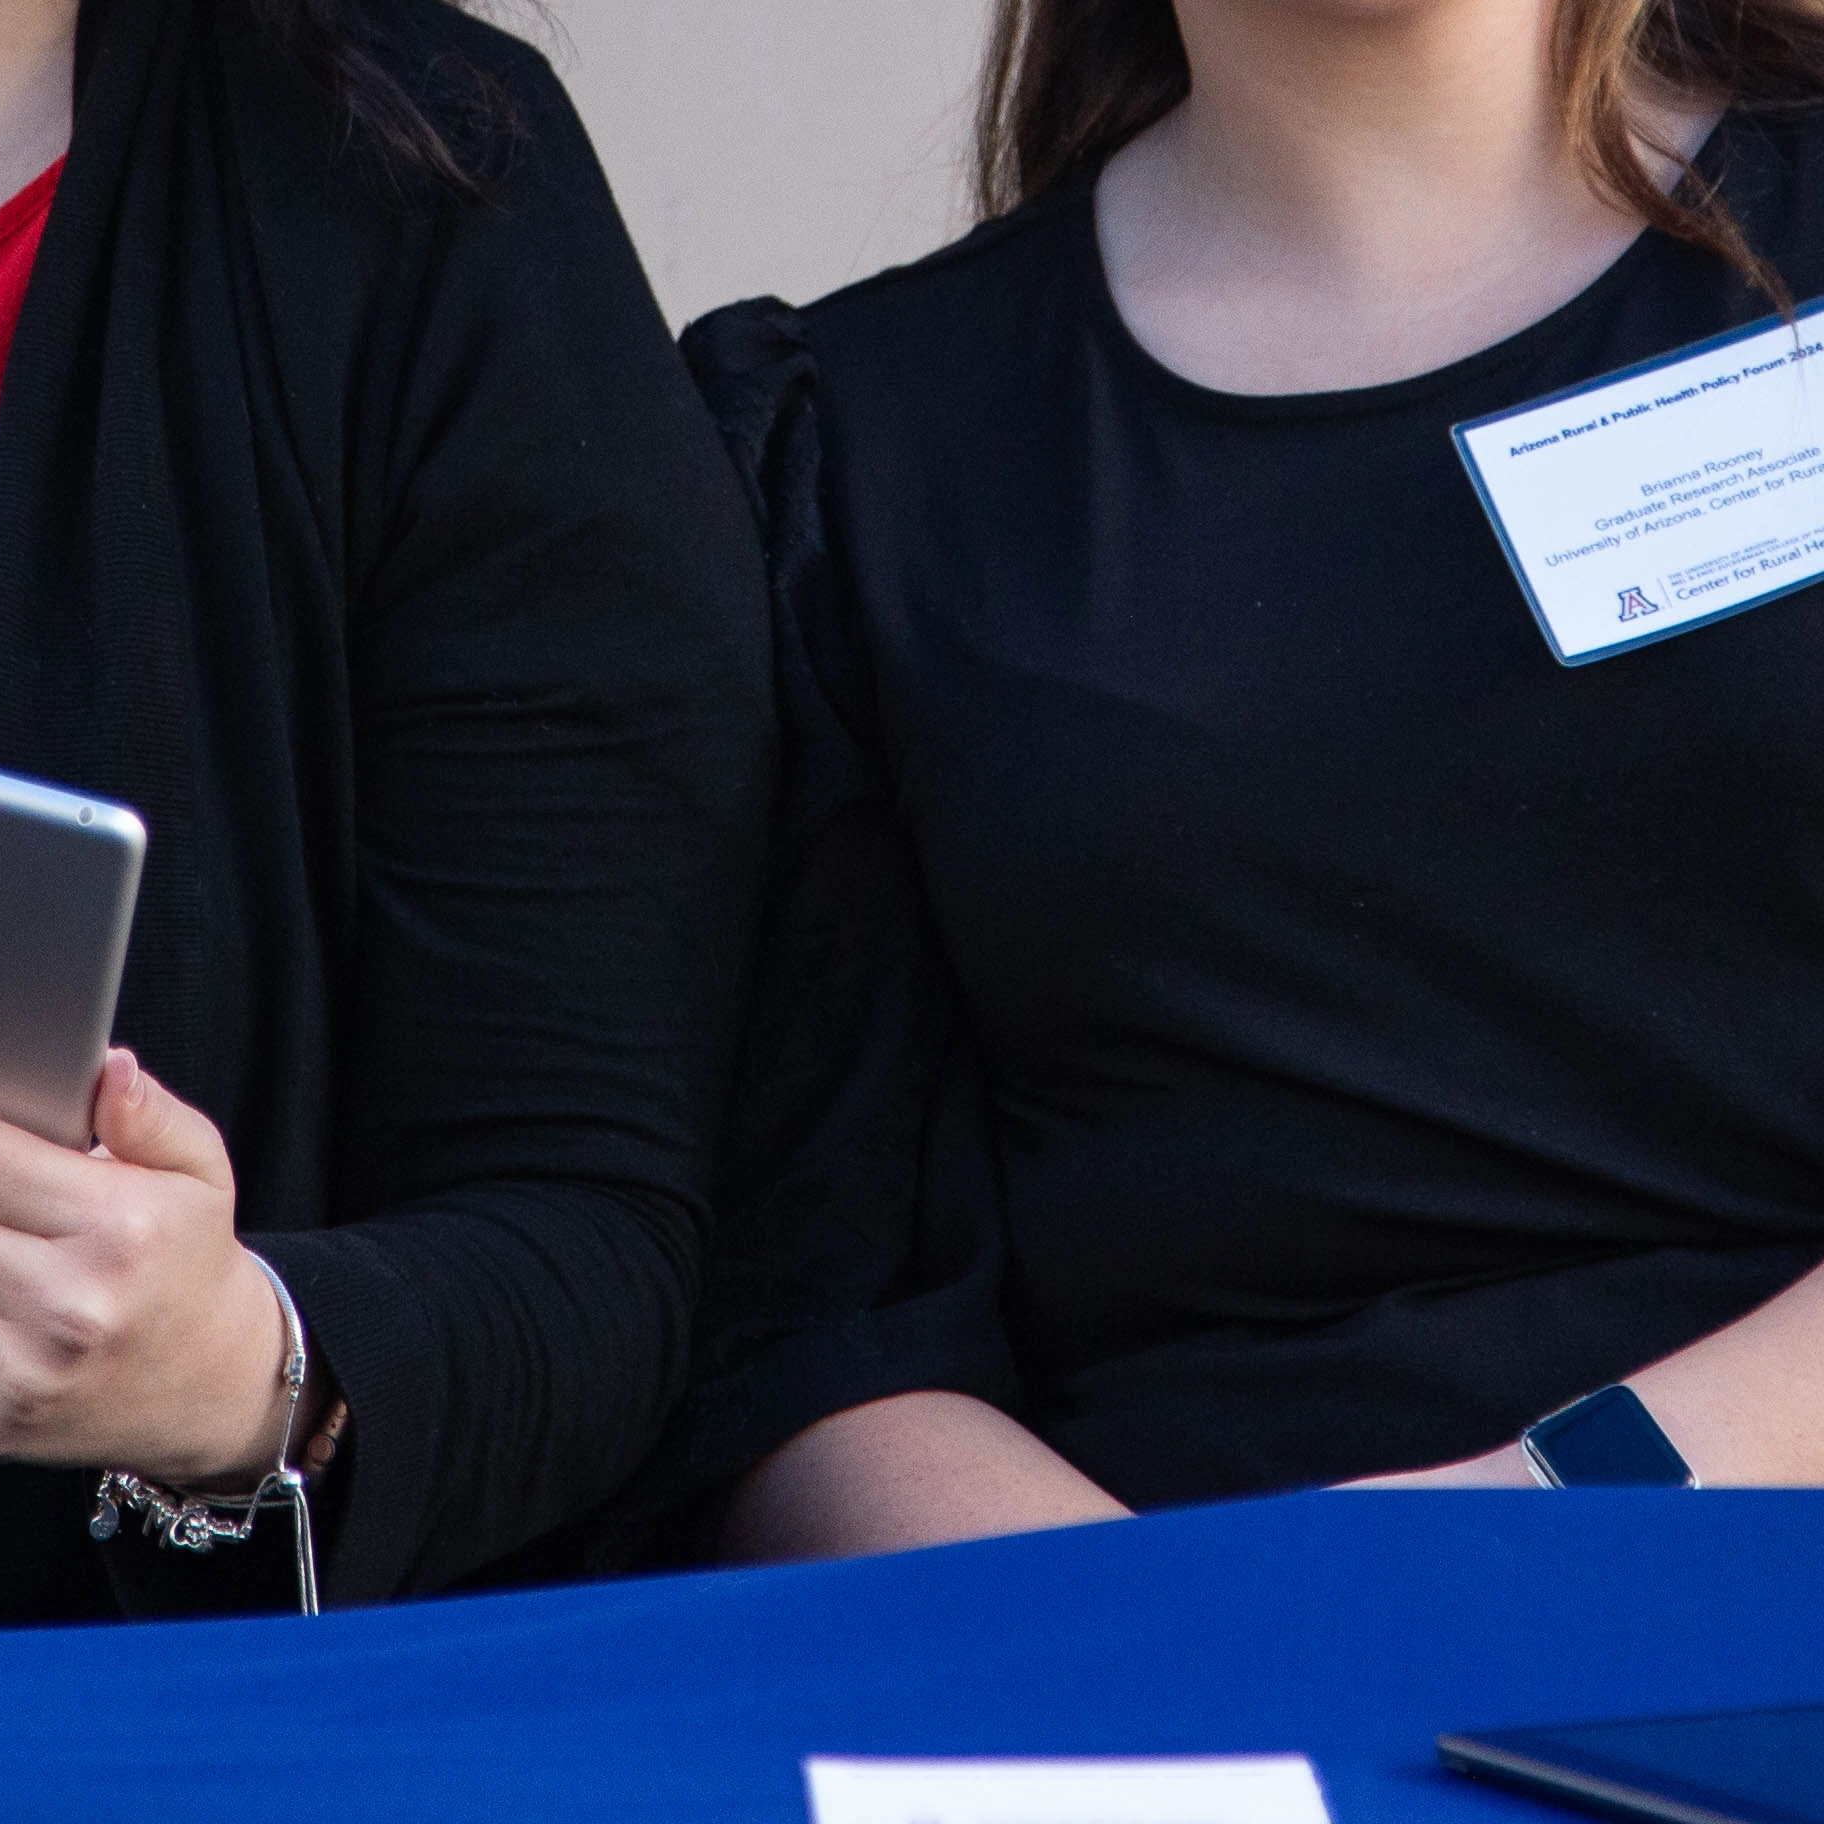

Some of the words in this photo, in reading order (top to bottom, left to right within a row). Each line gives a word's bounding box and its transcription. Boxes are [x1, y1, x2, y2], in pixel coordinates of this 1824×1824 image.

[1510, 435, 1560, 457] Arizona
[1561, 420, 1599, 439] Rural
[1600, 416, 1609, 427] &
[1611, 403, 1652, 423] Public
[1655, 386, 1699, 408] Health
[1701, 373, 1740, 393] Policy
[1742, 356, 1786, 377] Forum
[1788, 341, 1824, 363] 2024
[1594, 500, 1667, 531] Graduate
[1670, 472, 1744, 505] Research
[1747, 445, 1822, 479] Associate
[1640, 468, 1702, 497] Brianna
[1704, 447, 1764, 475] Rooney
[1544, 534, 1622, 568] University
[1625, 525, 1641, 541] of
[1709, 485, 1761, 511] Center
[1764, 476, 1786, 492] for
[1617, 586, 1660, 623] A
[1676, 575, 1731, 601] Center
[1733, 566, 1757, 581] for
[1760, 546, 1803, 572] Rural
